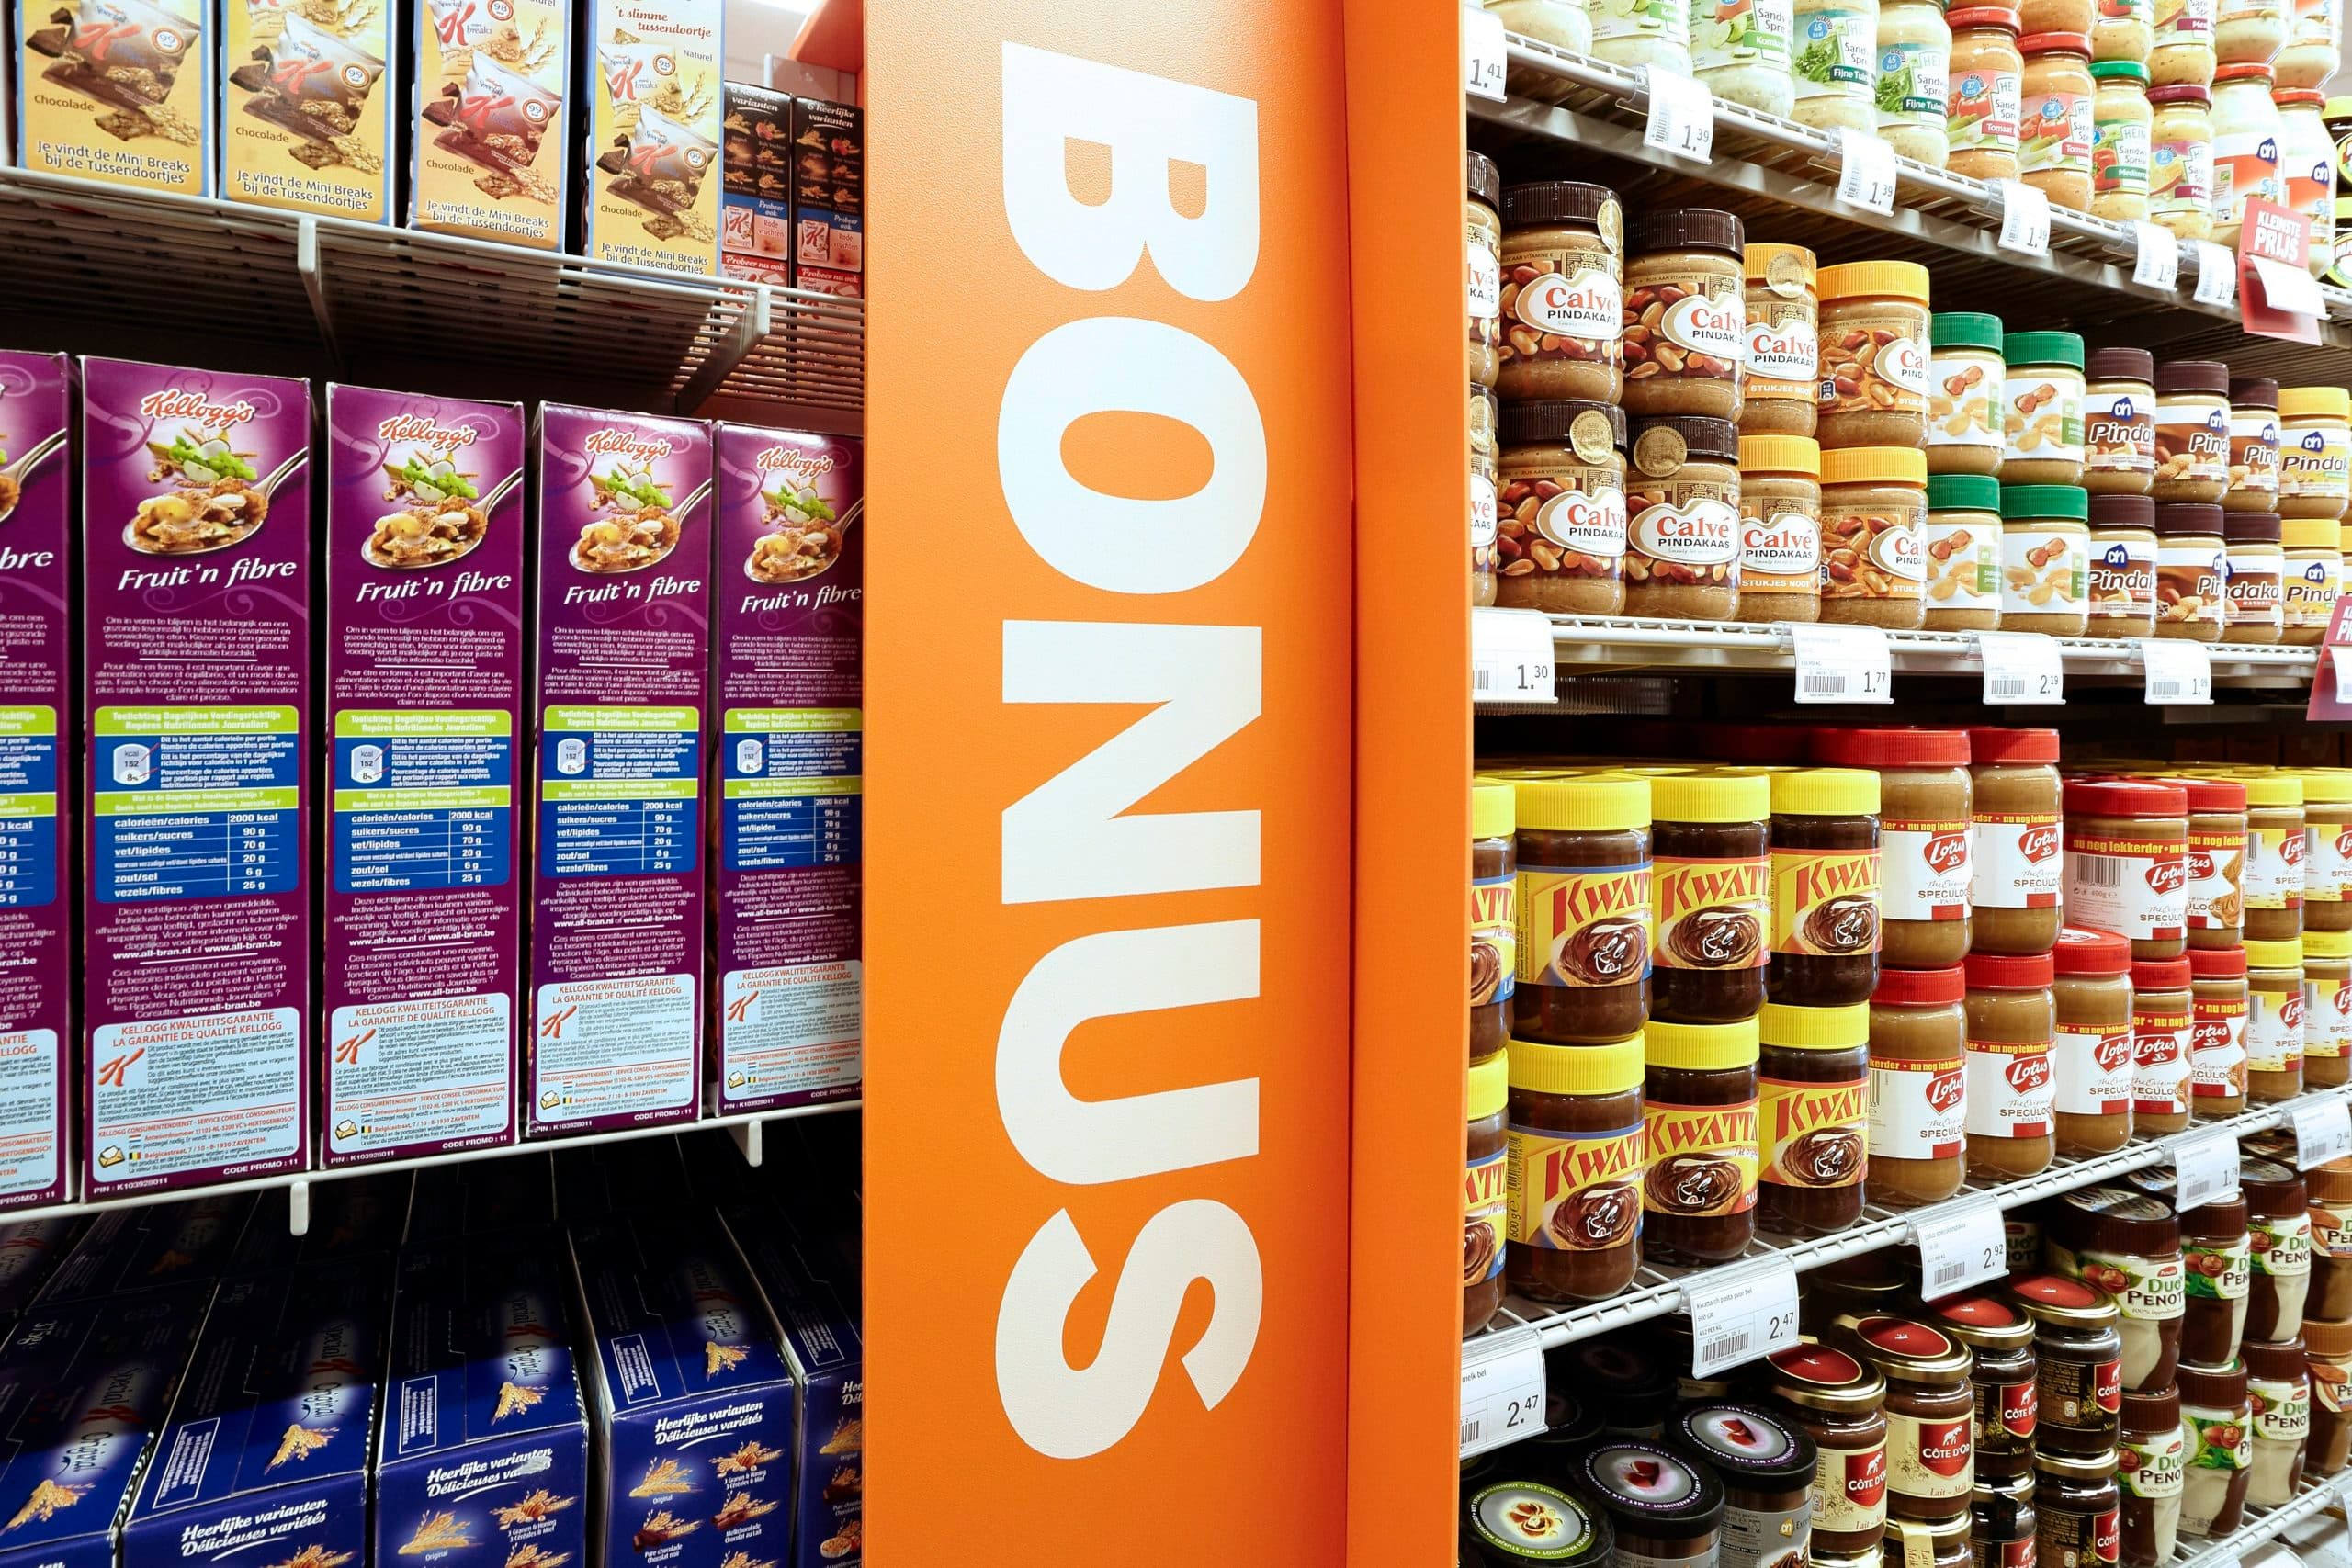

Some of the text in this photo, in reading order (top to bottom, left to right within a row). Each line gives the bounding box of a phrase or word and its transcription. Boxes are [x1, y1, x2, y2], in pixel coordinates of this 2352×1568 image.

[627, 8, 668, 23] slimme
[637, 21, 713, 39] tussendoortje
[683, 49, 714, 62] Naturel
[1470, 57, 1502, 89] 1.41
[34, 94, 95, 113] Chocolade
[732, 96, 779, 112] varianten
[817, 104, 855, 119] heerlijke
[808, 112, 854, 129] varianten
[235, 127, 289, 143] Chocolade
[1681, 125, 1709, 152] 1.39
[37, 141, 190, 174] Je vindt de Mini Breaks
[45, 152, 186, 185] bij de Tussendoortjes
[426, 159, 475, 175] Chocolade
[237, 169, 373, 201] Je vindt de Mini Breaks
[243, 182, 368, 211] bij de Tussendoortjes
[1868, 181, 1893, 205] 1.39
[427, 199, 549, 229] Je vindt de Mini Breaks
[600, 205, 643, 218] Chocolade
[433, 209, 545, 238] bij de Tussendoortjes
[601, 243, 708, 266] Je vindt de Mini Breaks
[606, 253, 620, 265] bij
[622, 254, 636, 265] de
[726, 256, 758, 269] Probeer
[770, 263, 785, 272] ook
[142, 392, 254, 426] Kellogg's
[380, 415, 476, 448] Kellogg's
[587, 431, 671, 461] Kellogg's
[758, 449, 832, 478] Kellogg's
[1657, 514, 1730, 538] Calvé
[1658, 537, 1730, 549] PINDAKAAS
[1744, 528, 1813, 550] Calvé
[1746, 548, 1813, 560] PINDAKAAS
[118, 558, 297, 591] Fruit'n fibre
[1742, 578, 1786, 588] STUKJES
[356, 571, 512, 603] Fruit'n fibre
[563, 576, 701, 604] Fruit'n fibre
[741, 585, 862, 614] Fruit'n fibre
[1517, 664, 1548, 690] 1.30
[1864, 671, 1886, 693] 1.77
[2040, 674, 2059, 694] 2.19
[998, 41, 1268, 1461] BONUS
[115, 812, 278, 829] calorieën/calories 2000 kcal
[115, 828, 256, 841] suikers/sucres 90
[2023, 831, 2058, 855] Lotus
[115, 841, 256, 856] vet/lipides 70
[1930, 835, 1966, 864] Lotus
[2109, 840, 2164, 853] lekkerder
[243, 854, 256, 863] 20
[115, 868, 254, 883] zout/sel 6
[115, 881, 256, 897] vezels/fibres 25
[112, 940, 282, 960] www.all-bran.nl www.all-bran.be
[183, 1000, 261, 1014] www.all-bran.be
[112, 1021, 282, 1047] LA GARANTIE DE QUALITÉ KELLOGG
[121, 1012, 275, 1035] KELLOGG KWALITEITSGARANTIE
[2134, 1038, 2175, 1060] Lotus
[2011, 1058, 2049, 1085] Lotus
[1930, 1077, 1964, 1104] Lotus
[223, 1165, 248, 1175] CODE
[250, 1160, 282, 1172] PROMO
[1984, 1244, 2004, 1269] 2.92
[1769, 1312, 1794, 1341] 2.47
[1477, 1369, 1487, 1379] bel
[655, 1401, 763, 1433] Heerlijke varianten
[1507, 1395, 1539, 1428] 2.47
[2005, 1407, 2028, 1420] CÔTE
[655, 1413, 763, 1445] Délicieuses variétés
[1922, 1447, 1951, 1458] CÔTE
[427, 1448, 553, 1484] Heerlijke varianten
[427, 1473, 501, 1497] Délicieuses
[1849, 1479, 1874, 1490] CÔTE
[182, 1498, 328, 1542] Heerlijke varianten
[182, 1512, 328, 1557] Délicieuses variétés
